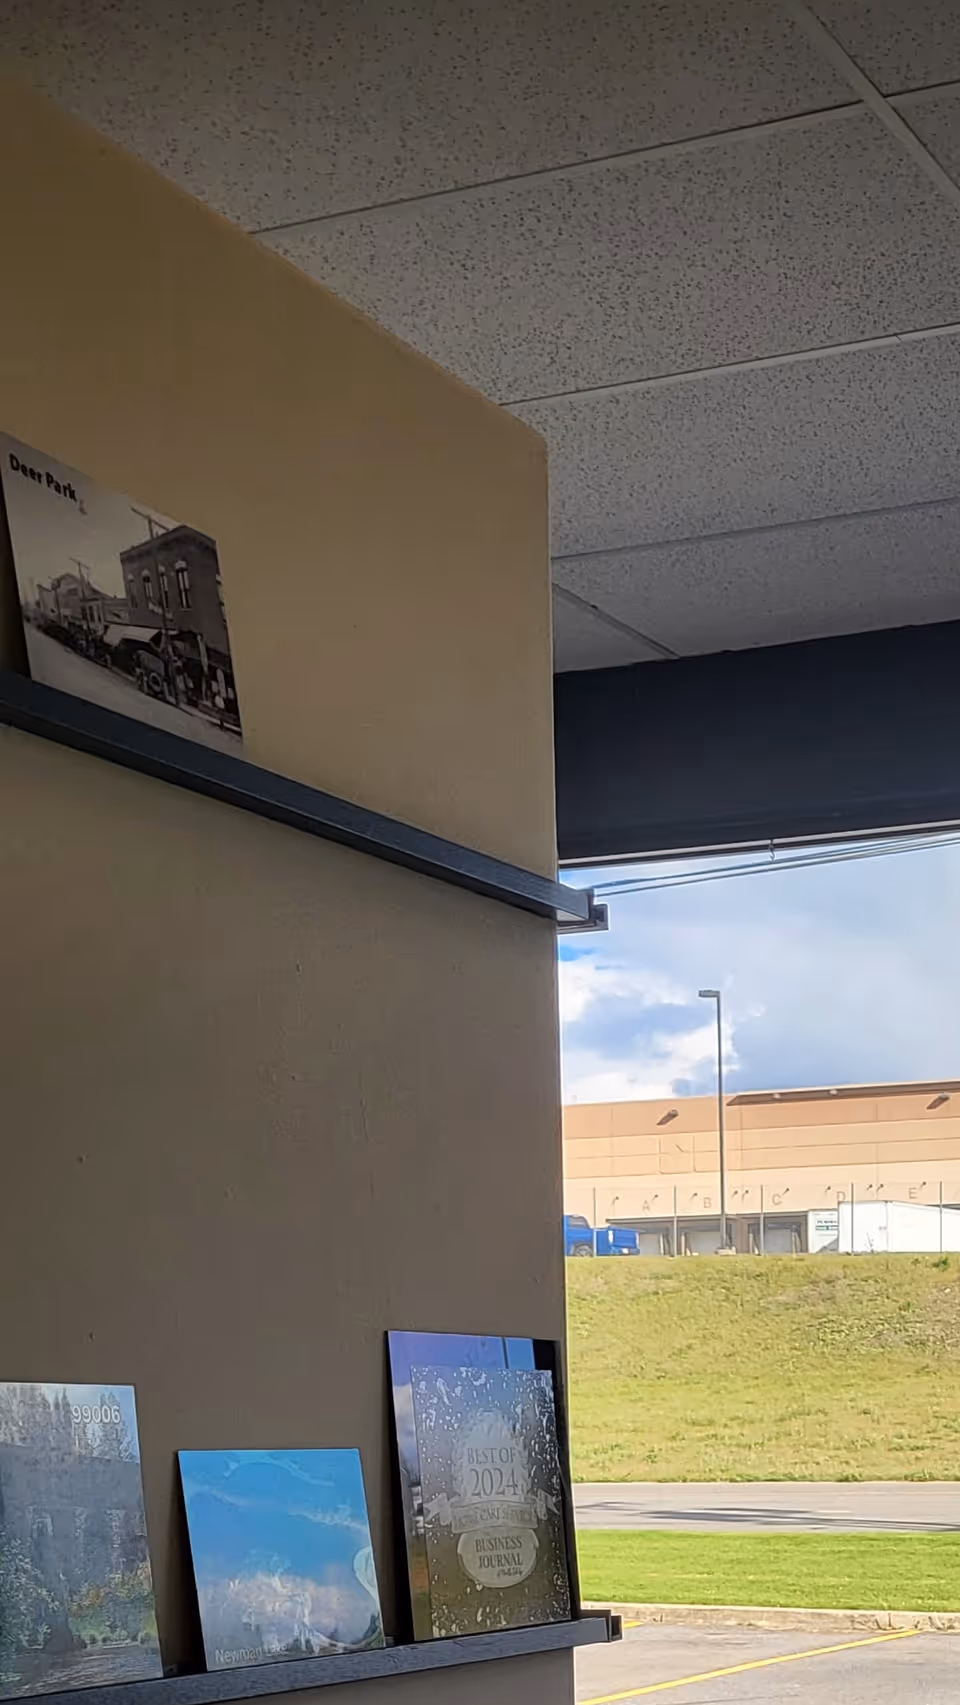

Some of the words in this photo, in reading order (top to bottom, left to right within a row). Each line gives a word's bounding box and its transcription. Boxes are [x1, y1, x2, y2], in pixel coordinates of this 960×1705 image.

[9, 453, 42, 484] Deer
[45, 471, 77, 502] Park
[772, 1194, 782, 1206] C
[909, 1187, 918, 1199] E
[642, 1200, 651, 1212] A
[703, 1197, 712, 1208] B
[72, 1405, 120, 1424] 99006
[467, 1448, 497, 1465] BEST
[500, 1447, 516, 1463] OF
[470, 1467, 519, 1497] 2024
[475, 1536, 523, 1552] BUSINESS
[478, 1552, 524, 1569] JOURNAL
[215, 1647, 263, 1664] Newman
[265, 1644, 289, 1657] Lake
